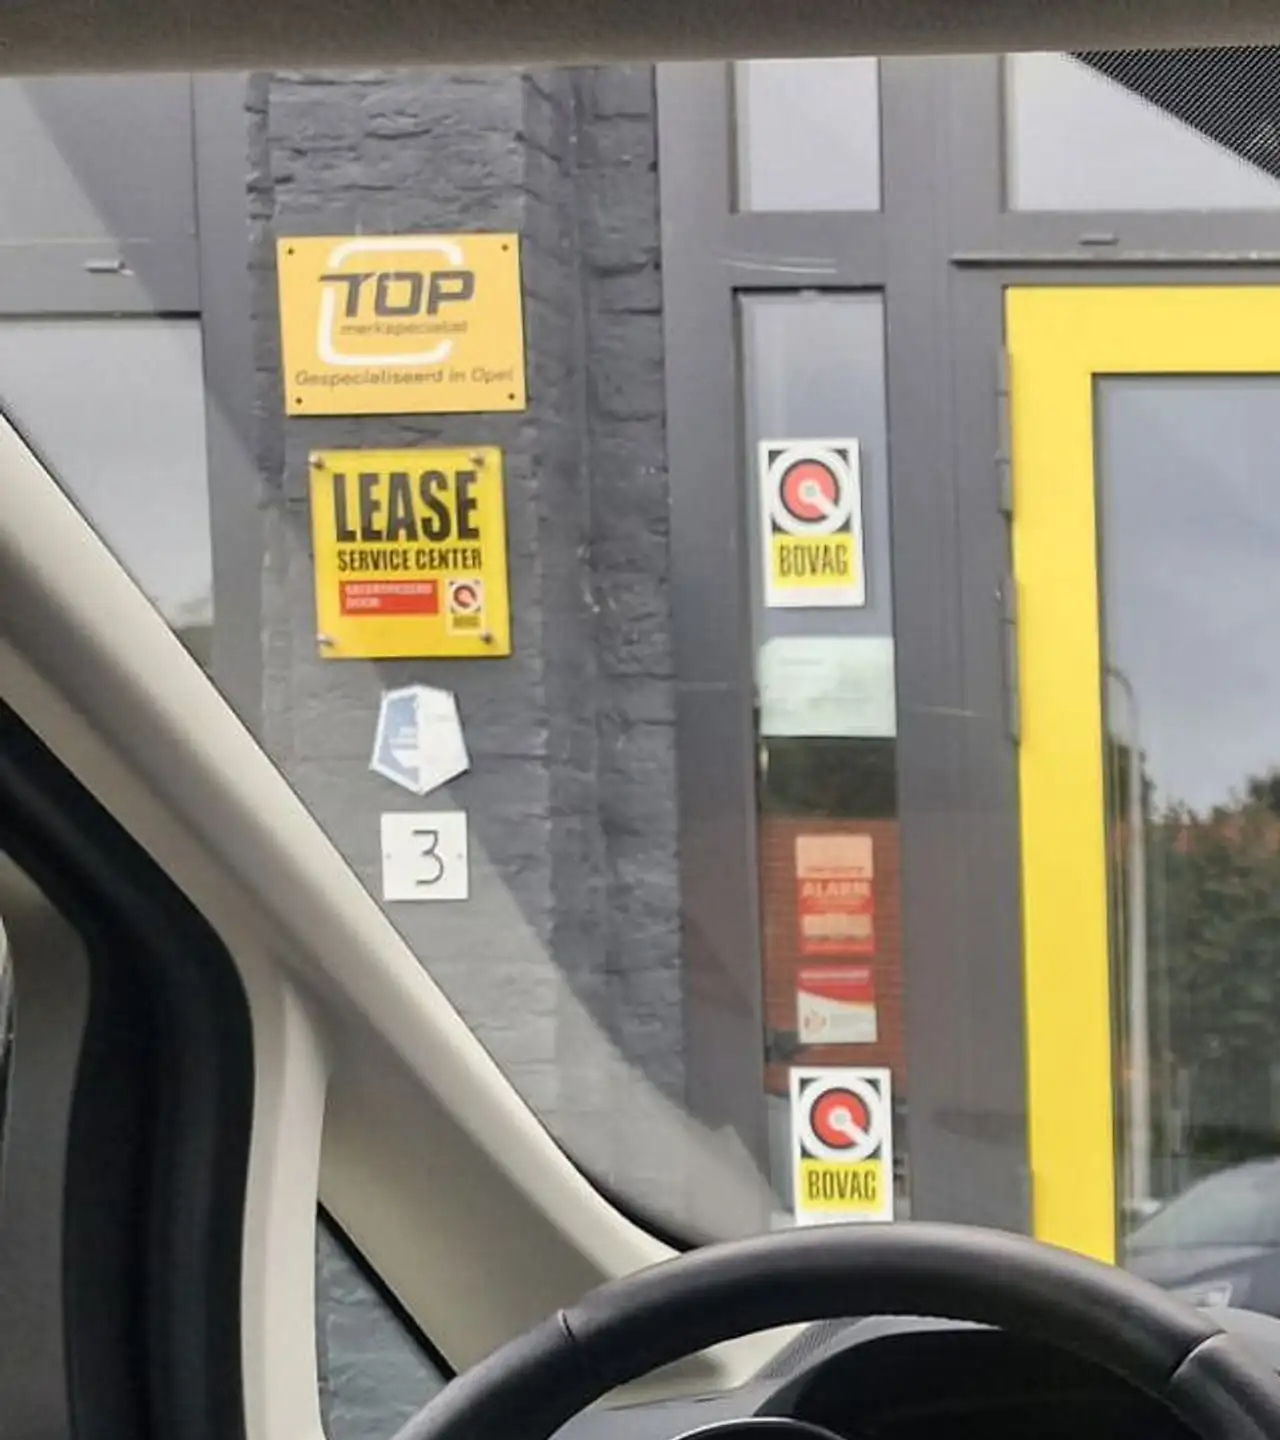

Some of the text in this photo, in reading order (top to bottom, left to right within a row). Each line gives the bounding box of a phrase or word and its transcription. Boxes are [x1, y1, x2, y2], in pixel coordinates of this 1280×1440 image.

[318, 270, 475, 318] TOP
[295, 367, 514, 389] Gespecialiseerd in Opel
[333, 470, 480, 543] LEASE
[337, 548, 482, 572] SERVICE CENTER
[778, 543, 848, 578] BOVAG
[411, 829, 444, 885] 3
[807, 1169, 876, 1201] BOVAG
